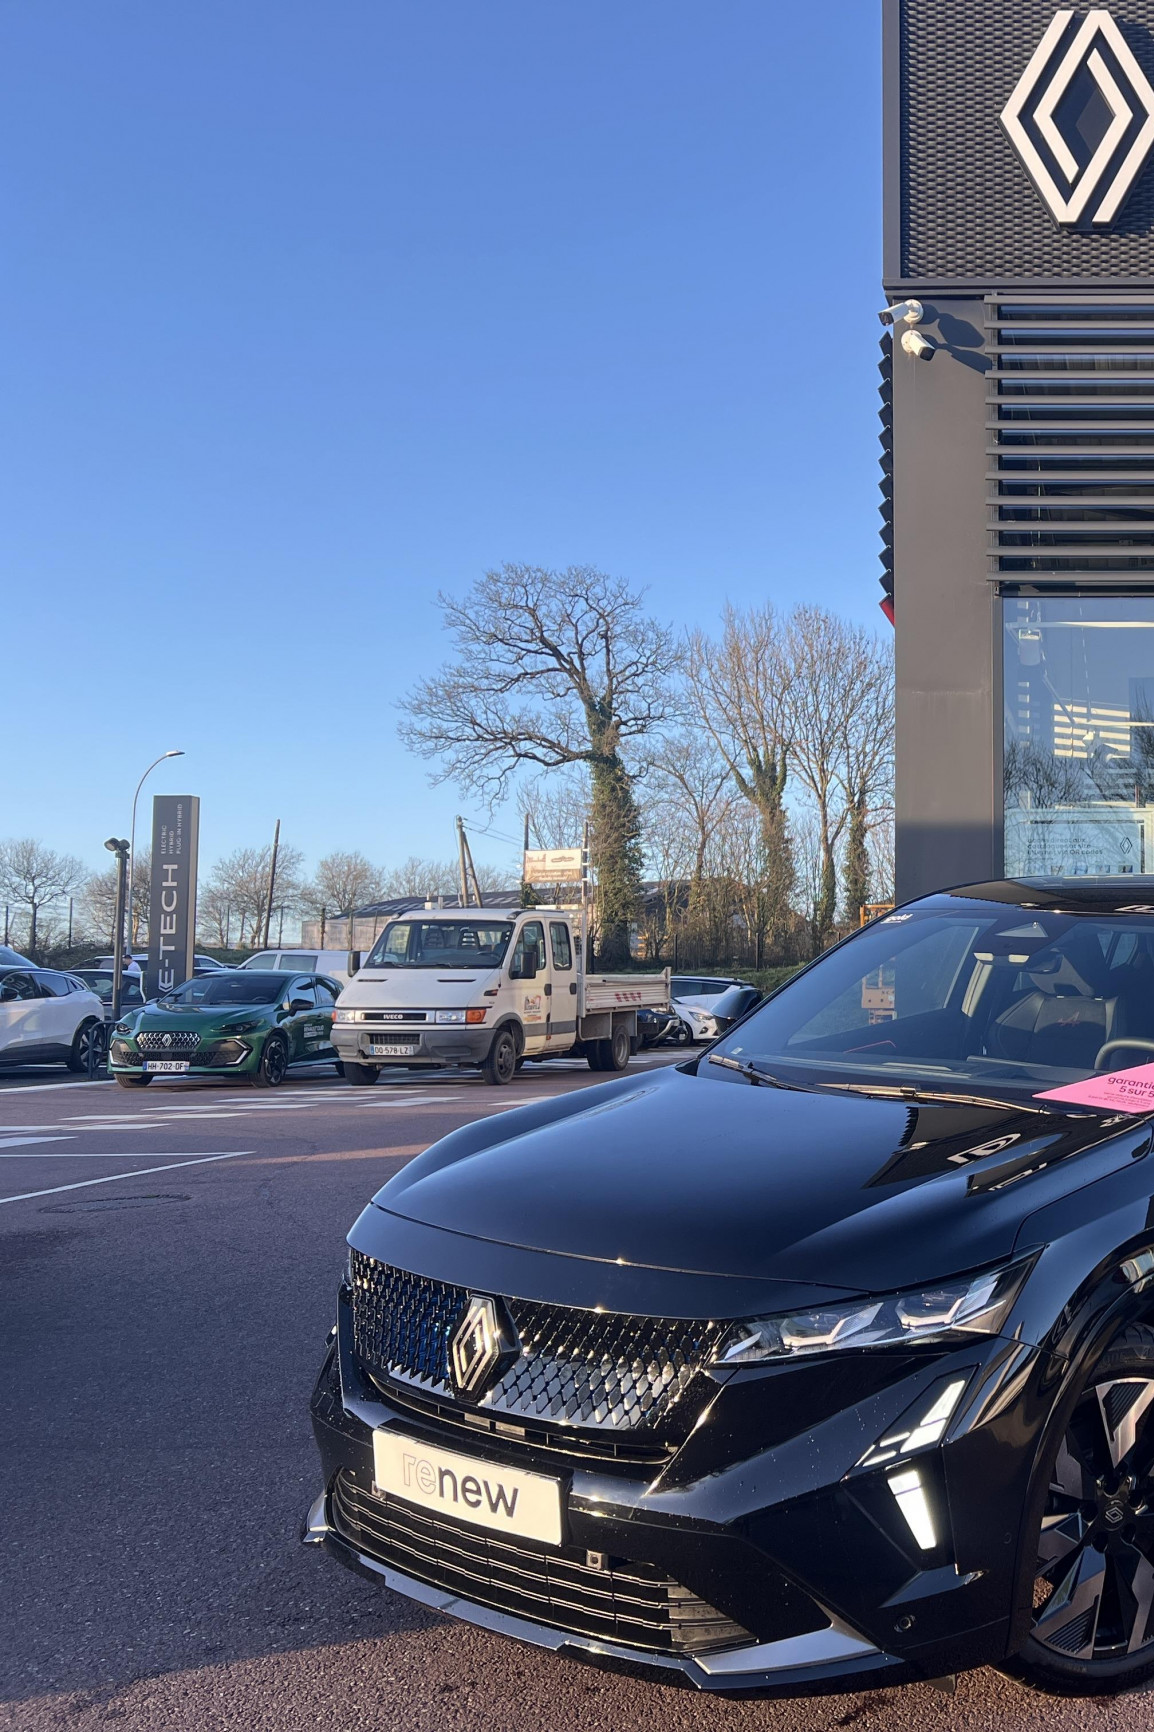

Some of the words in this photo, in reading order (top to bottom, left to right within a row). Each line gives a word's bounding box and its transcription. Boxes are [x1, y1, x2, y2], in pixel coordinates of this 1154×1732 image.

[159, 864, 178, 992] E-TECH
[1128, 1088, 1147, 1096] sur
[402, 1452, 519, 1519] renew
